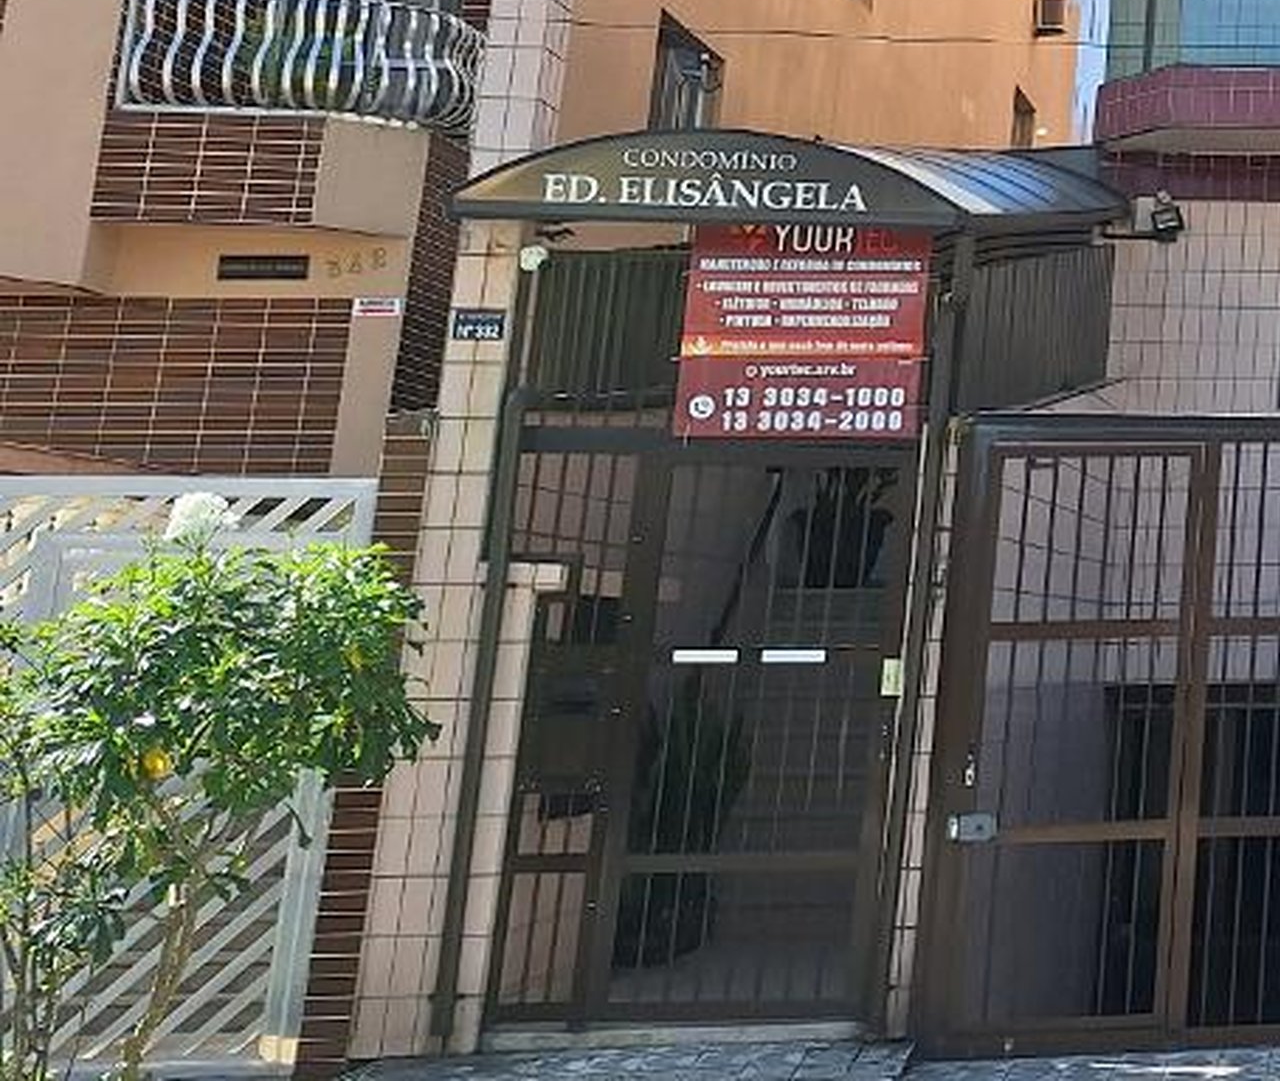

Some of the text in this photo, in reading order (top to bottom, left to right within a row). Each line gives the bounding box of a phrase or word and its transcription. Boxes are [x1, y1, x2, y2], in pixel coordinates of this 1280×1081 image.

[623, 148, 797, 169] CONDOMÍNIO
[543, 172, 867, 211] ED. ELISÂNGELA
[723, 388, 905, 406] 13 3034-1000
[722, 411, 902, 430] 13 3034-2000
